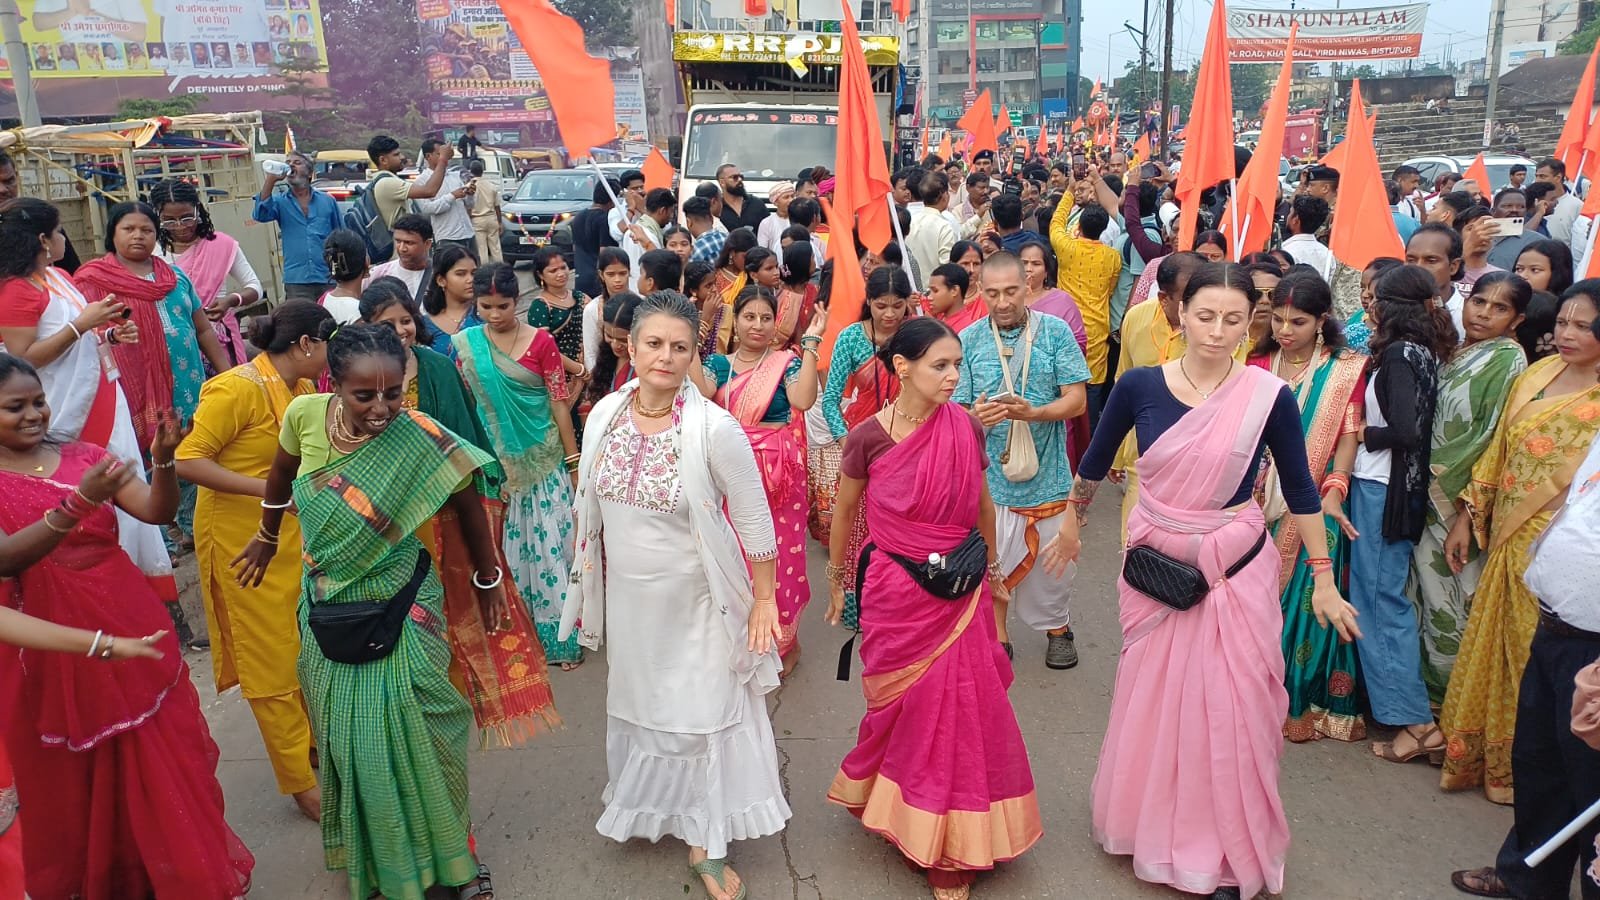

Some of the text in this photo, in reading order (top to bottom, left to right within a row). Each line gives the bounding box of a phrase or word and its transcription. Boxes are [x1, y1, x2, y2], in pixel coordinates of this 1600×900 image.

[1246, 10, 1407, 28] SHAKUNTALAM
[724, 34, 842, 54] RR DJ
[1239, 50, 1265, 58] ROAD,
[1338, 48, 1369, 56] NIWAS,
[1371, 46, 1412, 55] BISTUPUR
[187, 85, 245, 94] DEFINITELY
[789, 114, 819, 124] RR
